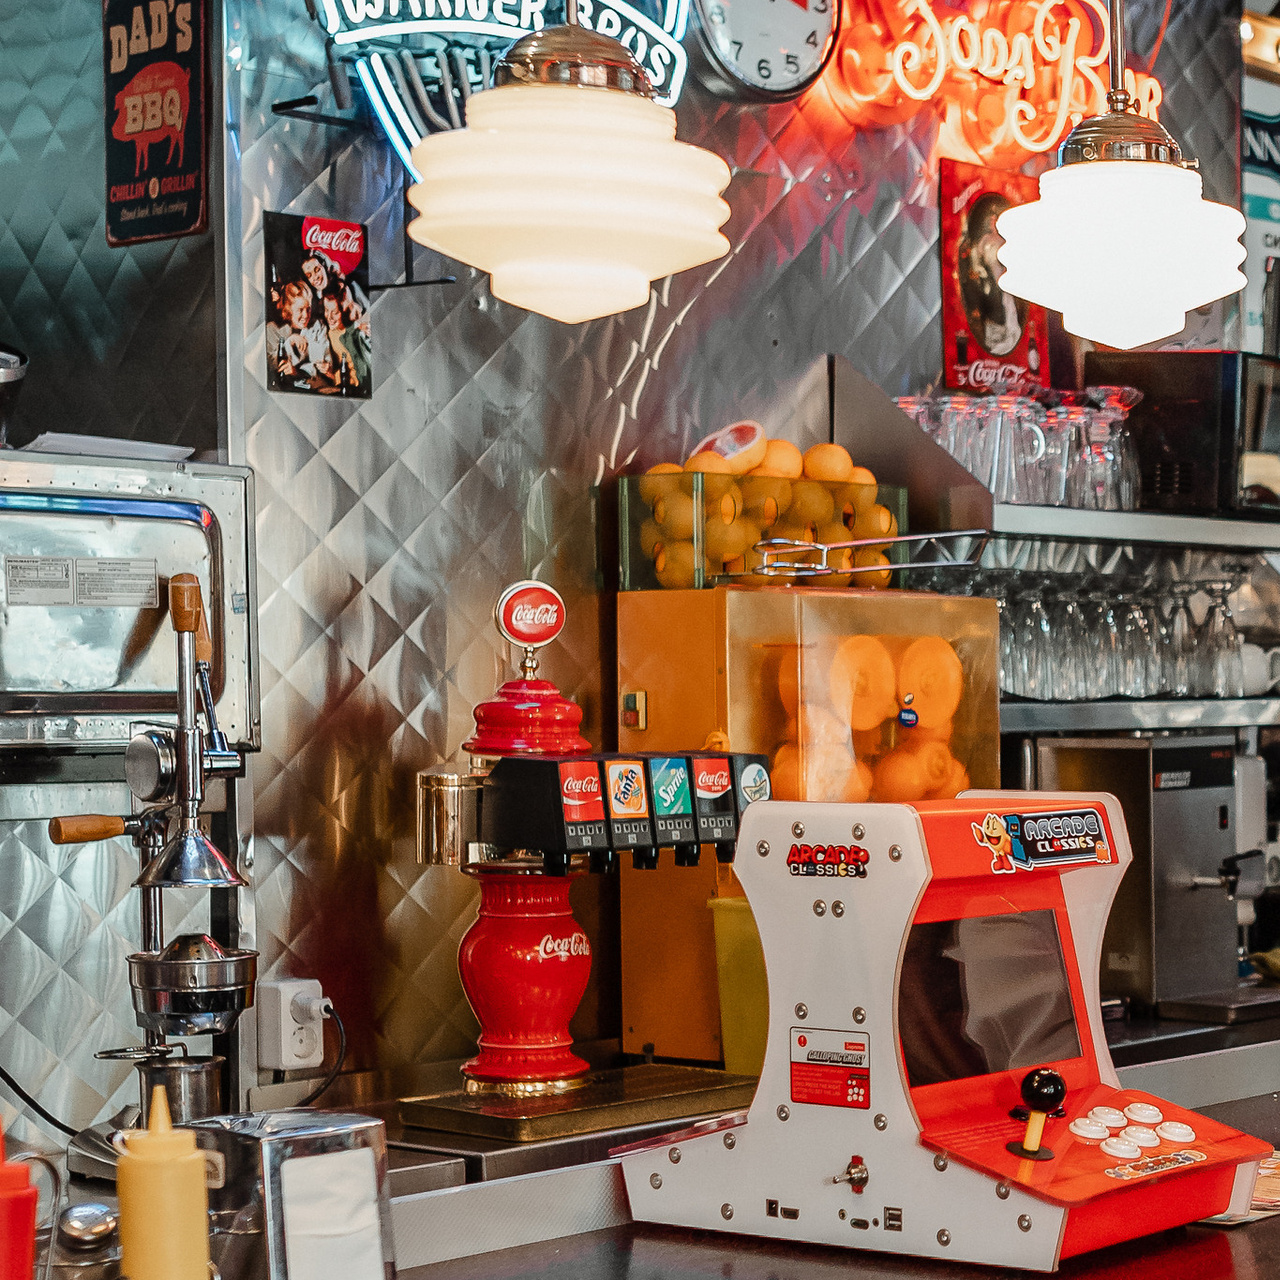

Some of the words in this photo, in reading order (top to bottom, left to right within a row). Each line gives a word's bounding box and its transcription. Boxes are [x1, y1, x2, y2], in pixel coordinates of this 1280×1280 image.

[806, 30, 819, 48] 4
[731, 40, 743, 61] 7
[757, 59, 772, 79] 6
[785, 54, 800, 75] 5
[124, 88, 183, 135] BBQ
[614, 768, 638, 806] Fanta
[658, 766, 686, 807] Sprite
[1023, 814, 1100, 841] ARCADE
[786, 843, 861, 867] ARCADE
[1037, 836, 1096, 853] CLSSICS
[790, 863, 857, 876] CLSSICS
